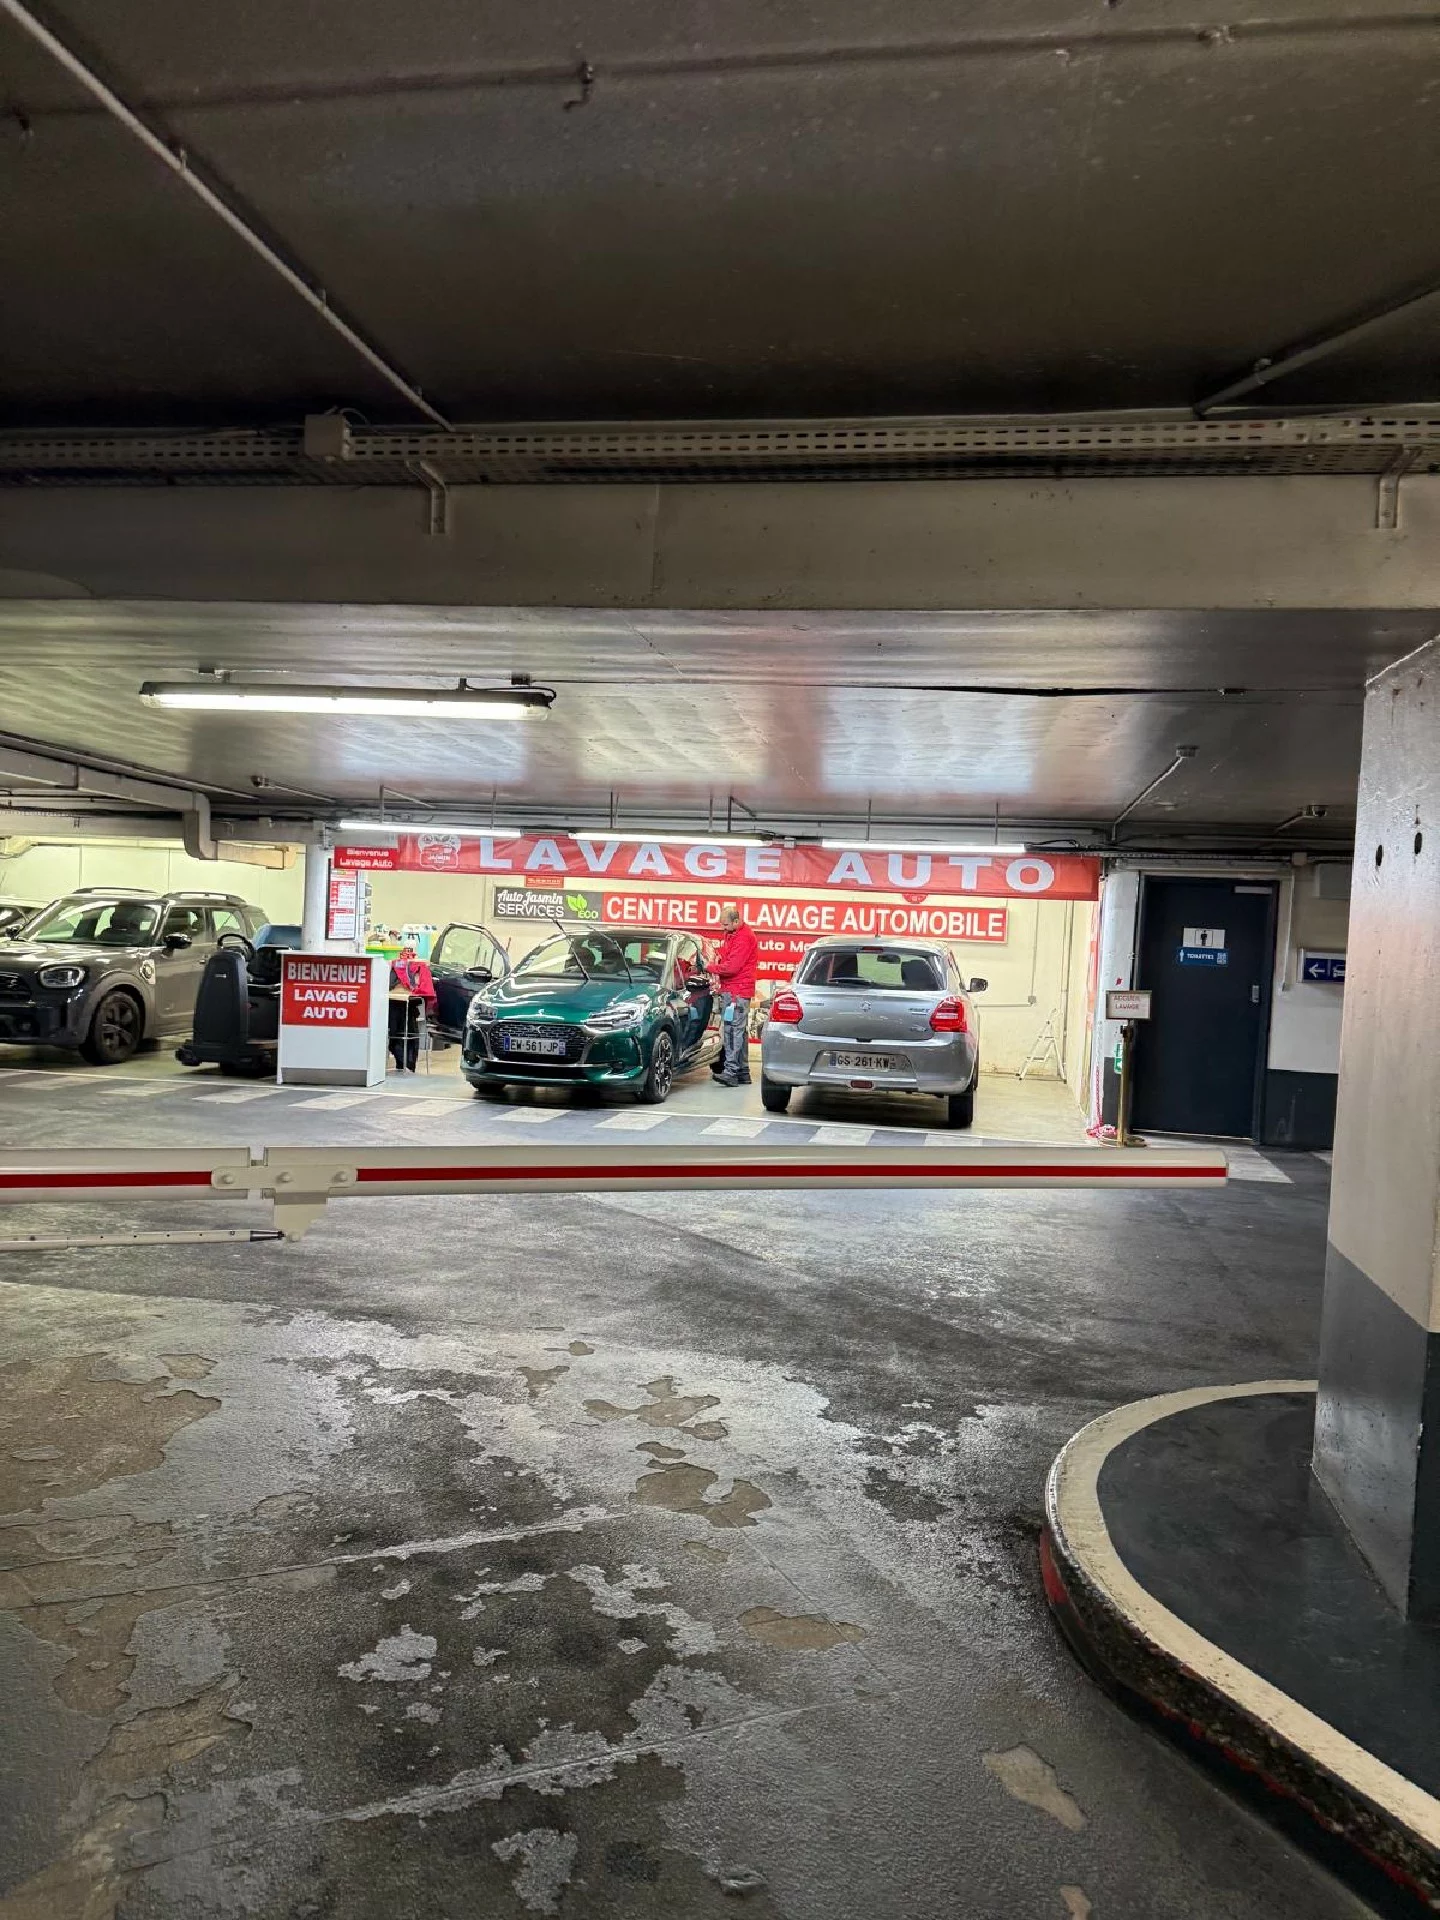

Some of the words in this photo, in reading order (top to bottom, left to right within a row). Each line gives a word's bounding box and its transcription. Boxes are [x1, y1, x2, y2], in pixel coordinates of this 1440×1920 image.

[346, 847, 390, 857] Bienvenue
[339, 858, 371, 868] Lavage
[372, 859, 393, 868] Auto
[480, 837, 782, 881] LAVAGE
[827, 851, 1056, 893] AUTO
[497, 889, 523, 903] Auto
[522, 891, 564, 906] Jasmin
[497, 903, 565, 918] SERVICES
[606, 896, 698, 923] CENTRE
[705, 901, 737, 925] D
[743, 904, 836, 930] LAVAGE
[841, 907, 1004, 937] AUTOMOBILE
[758, 940, 786, 951] uto
[287, 961, 367, 984] BIENVENUE
[293, 988, 359, 1003] LAVAGE
[302, 1006, 348, 1020] AUTO
